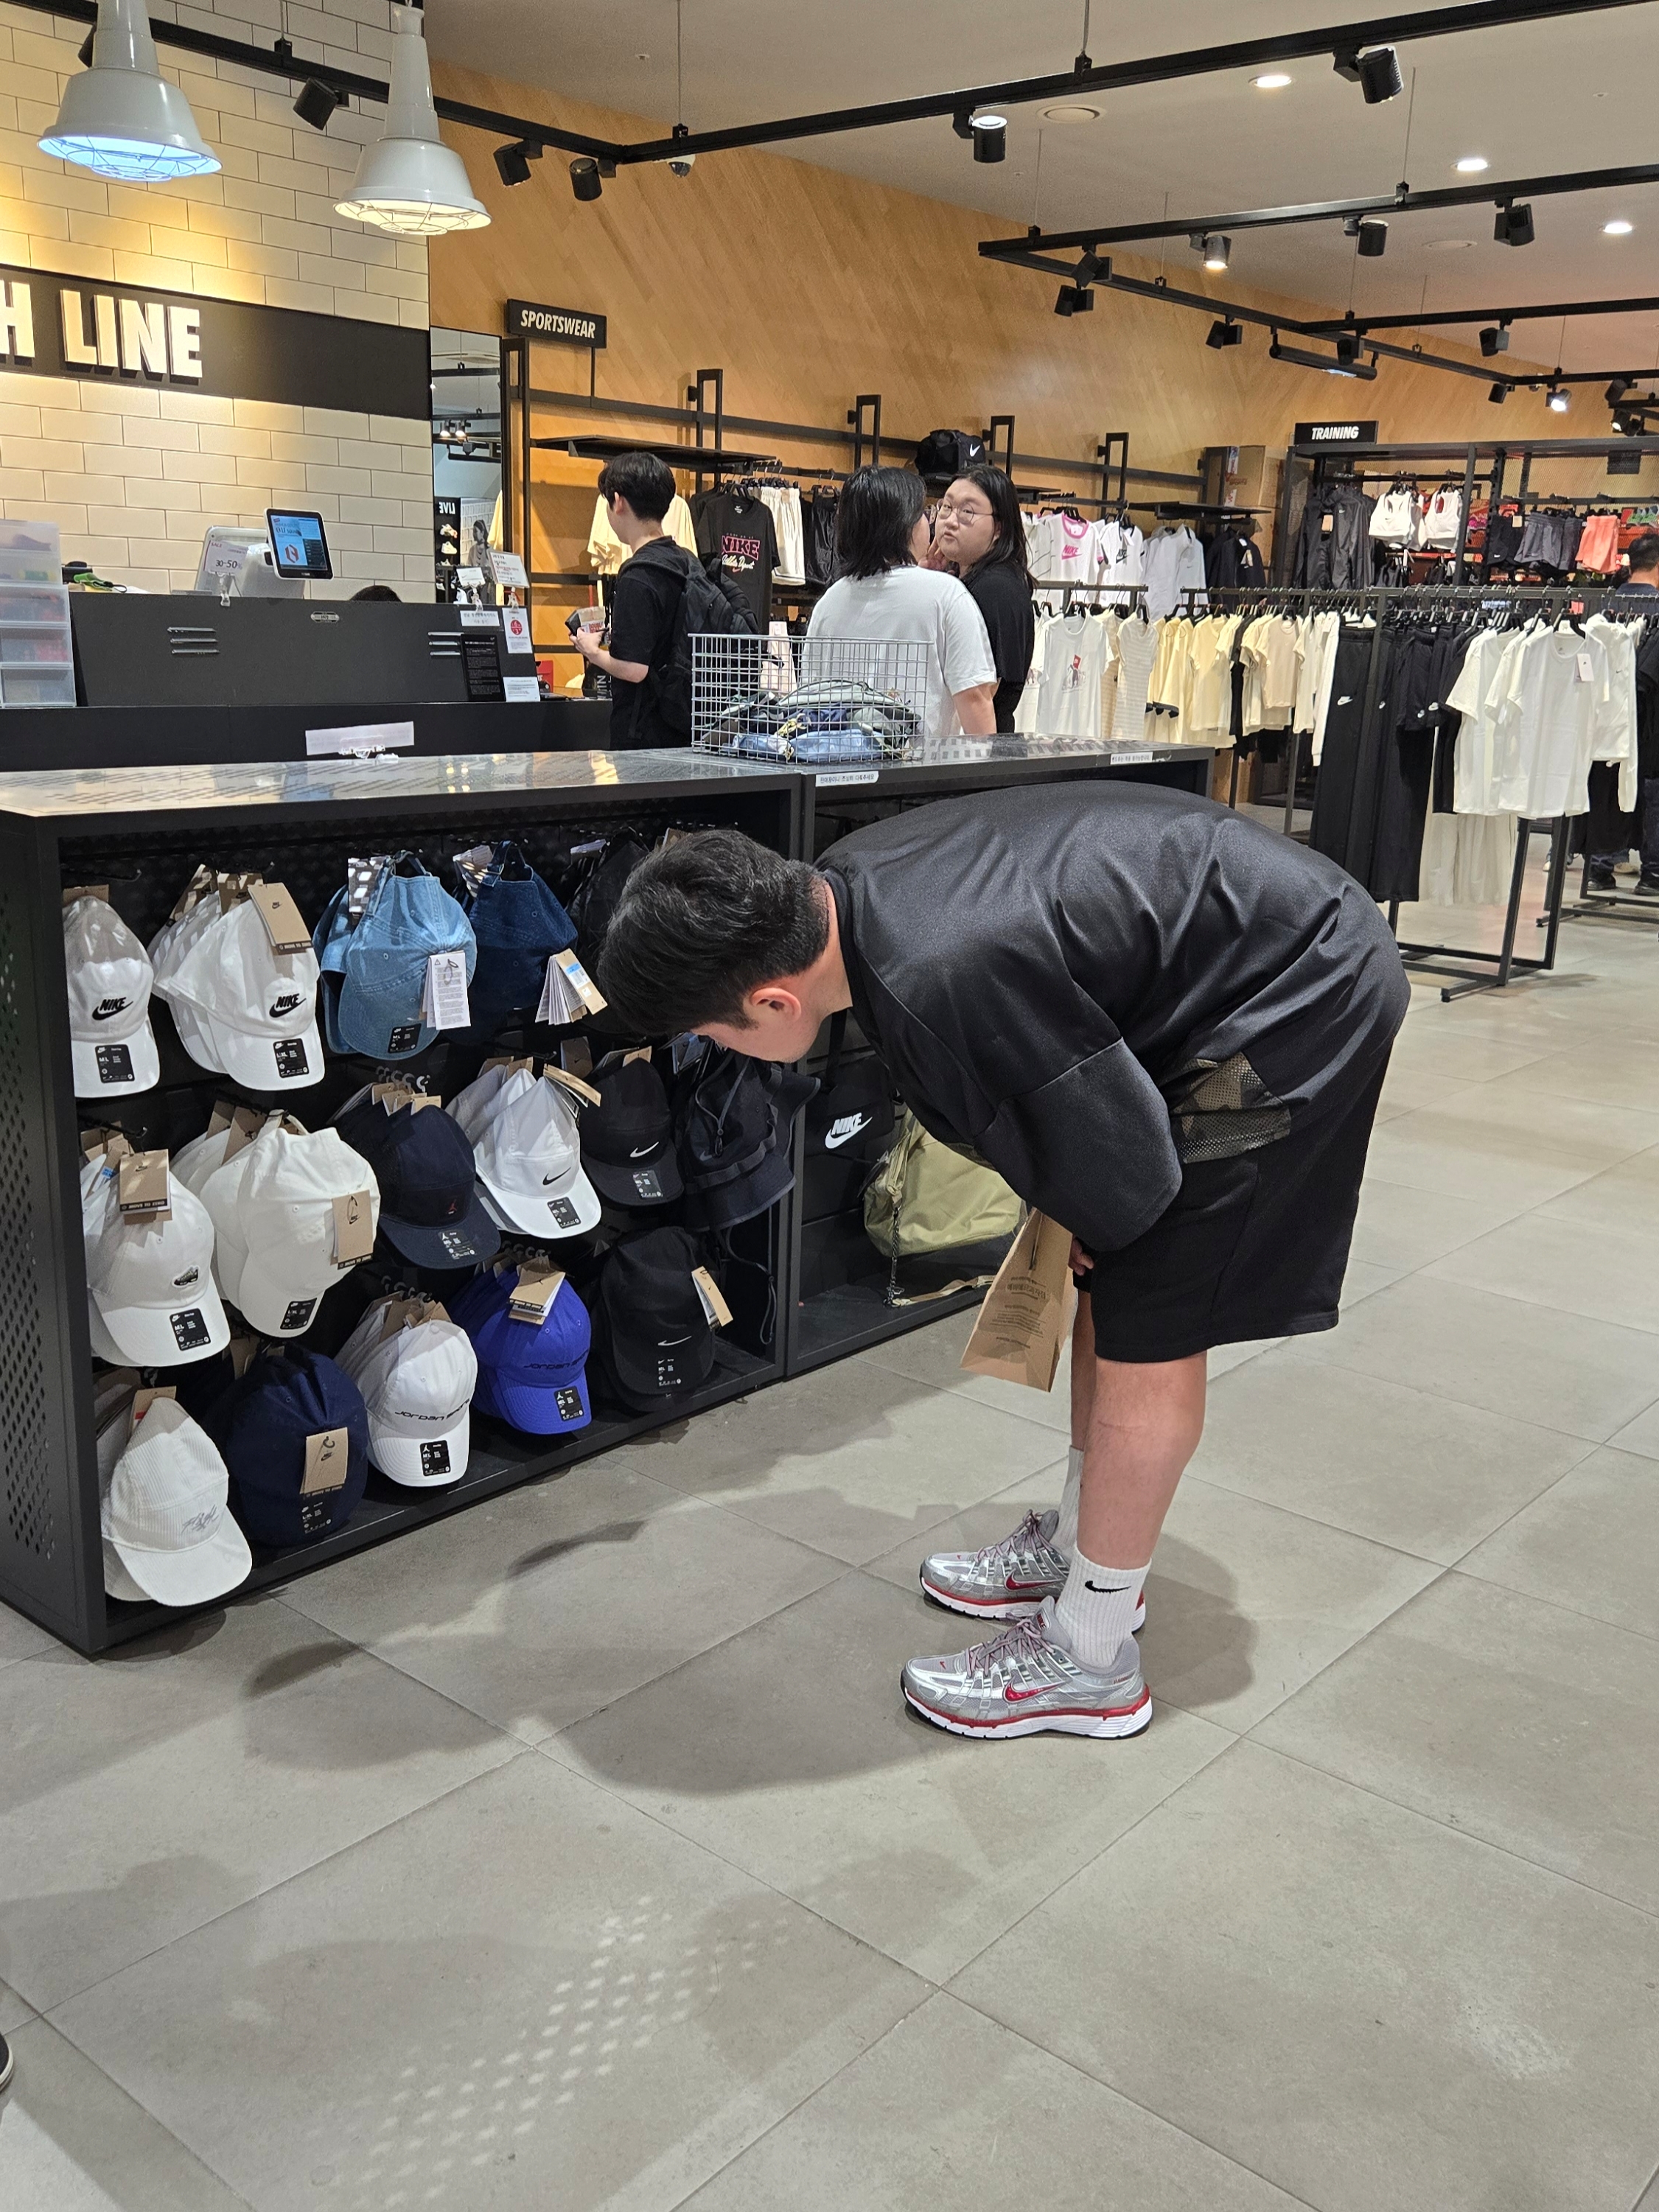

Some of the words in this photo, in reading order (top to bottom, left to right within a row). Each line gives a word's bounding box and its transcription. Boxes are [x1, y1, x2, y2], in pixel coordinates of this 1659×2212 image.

[60, 289, 203, 378] LINE
[520, 309, 596, 339] SPORTSWEAR
[1311, 425, 1359, 440] TRAINING
[722, 536, 760, 561] NIKE
[1063, 545, 1079, 555] NIKE
[99, 997, 126, 1011] NIKE
[831, 1112, 862, 1135] NIKE
